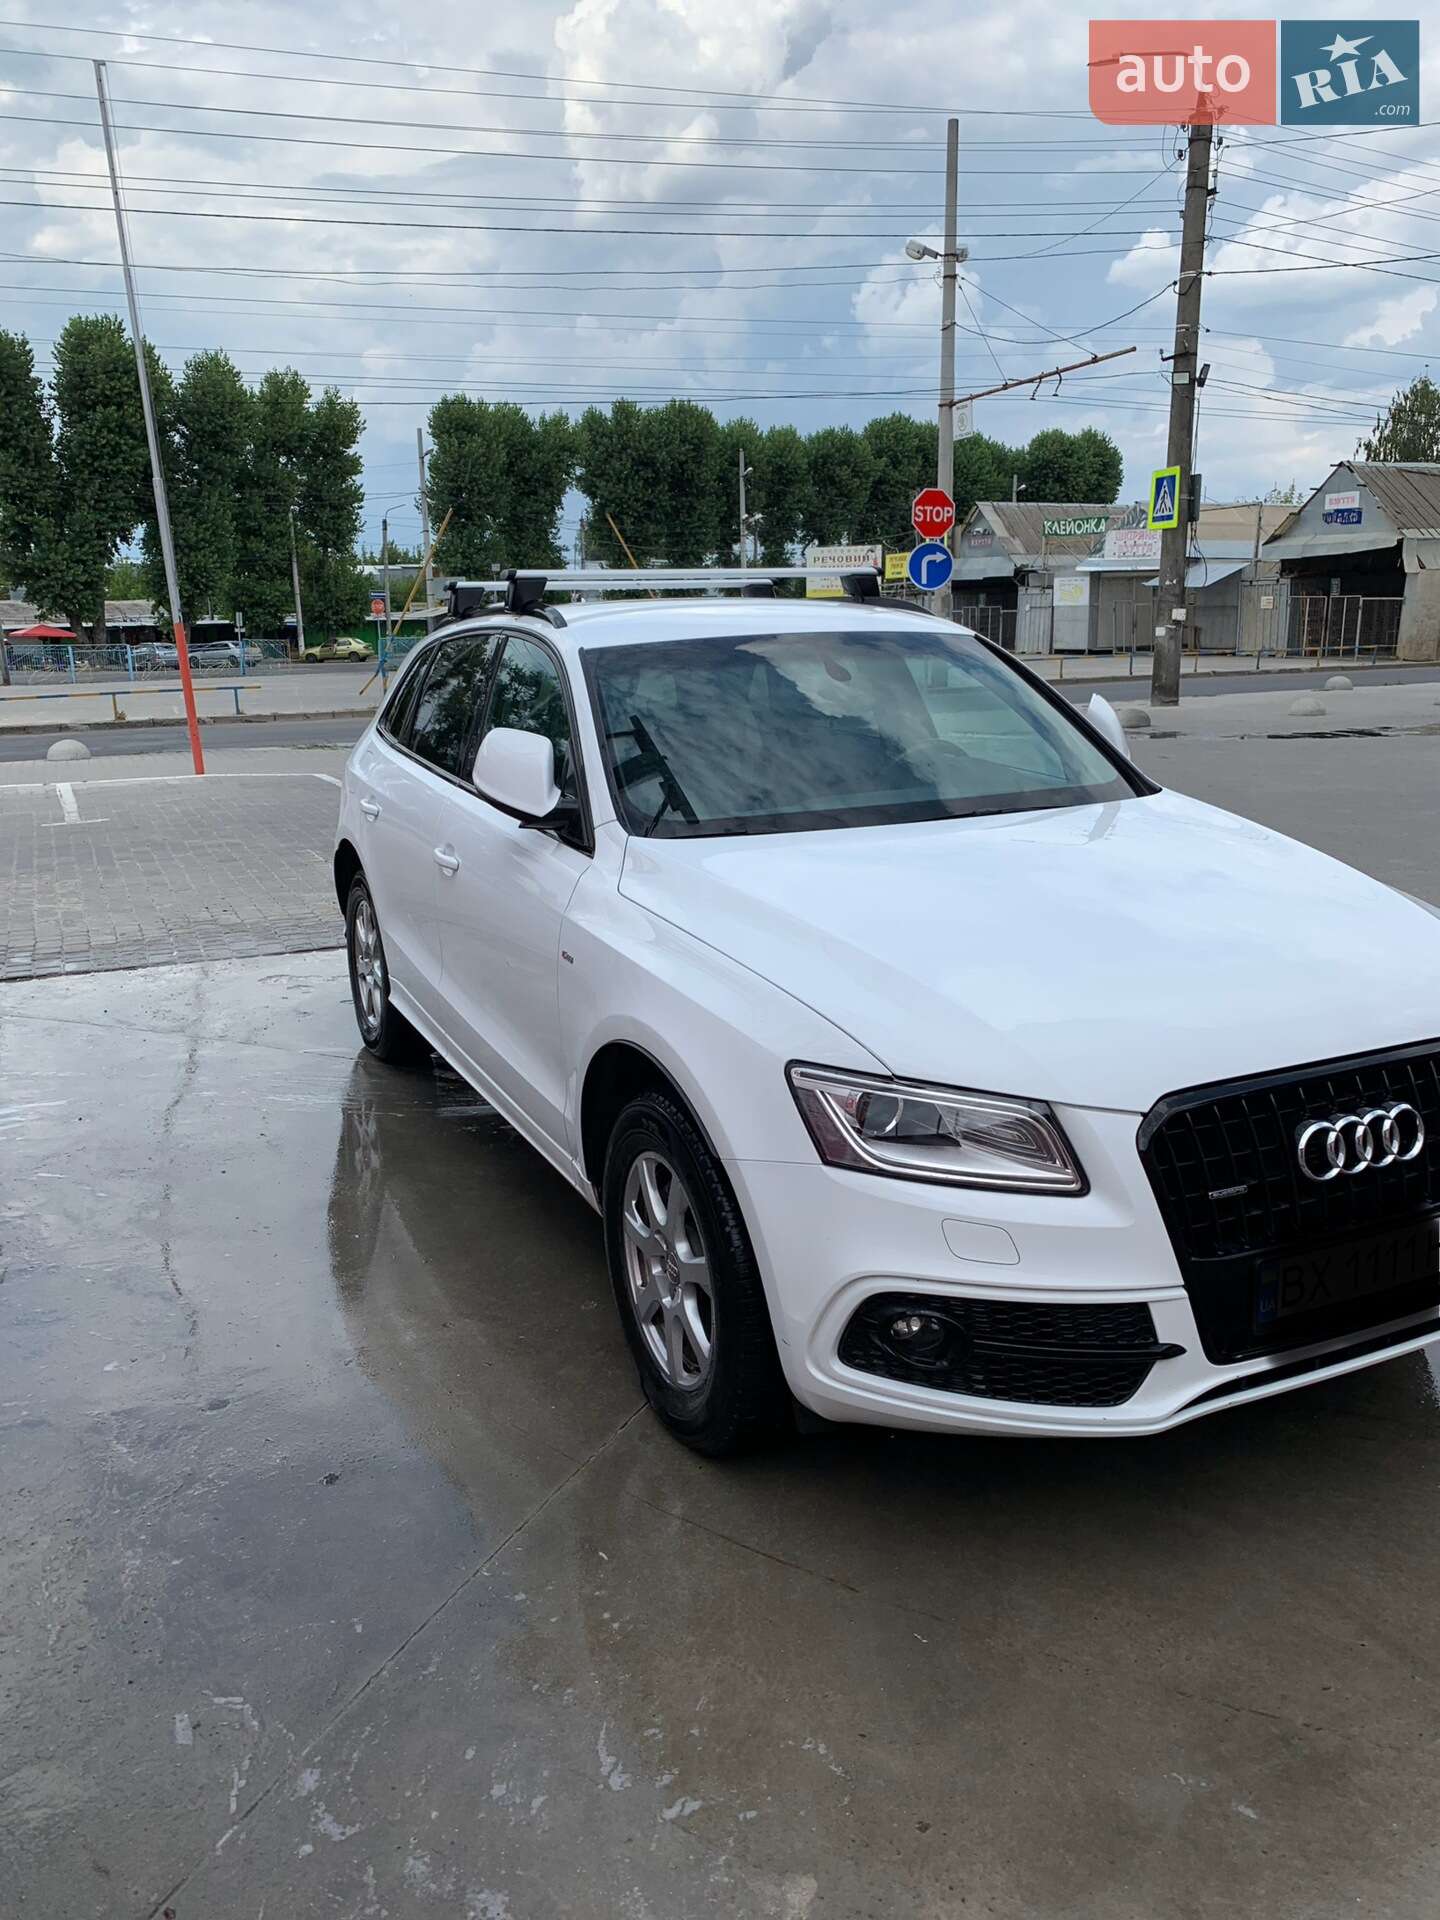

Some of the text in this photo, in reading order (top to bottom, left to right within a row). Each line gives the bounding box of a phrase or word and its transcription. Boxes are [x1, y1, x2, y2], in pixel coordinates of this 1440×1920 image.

[915, 506, 953, 523] STOP
[1044, 517, 1106, 535] КЛЕЙОНКА
[1282, 1255, 1332, 1308] BX
